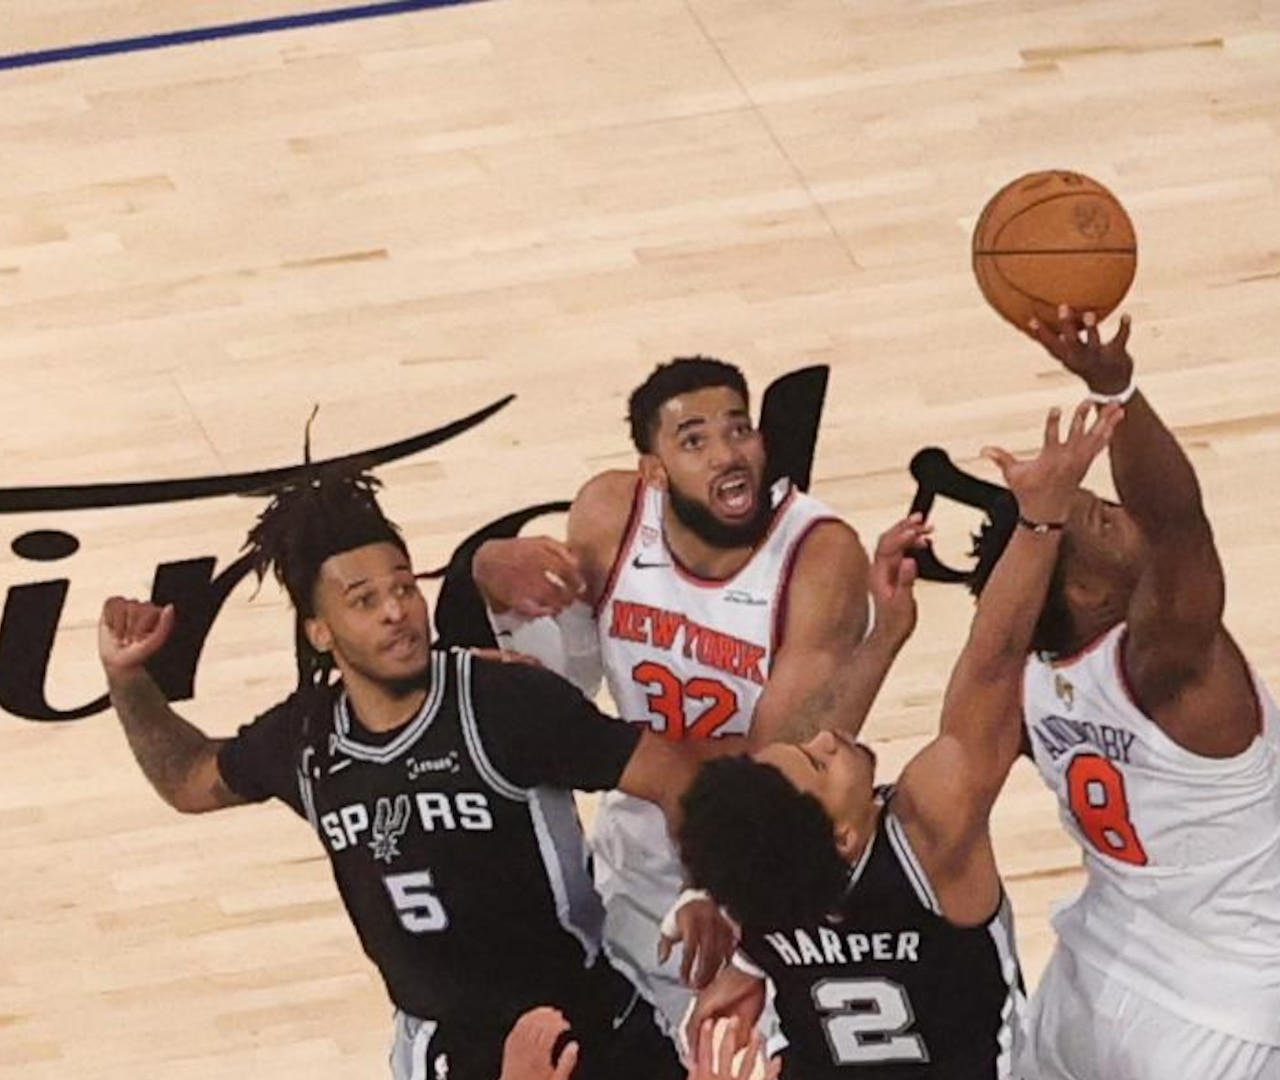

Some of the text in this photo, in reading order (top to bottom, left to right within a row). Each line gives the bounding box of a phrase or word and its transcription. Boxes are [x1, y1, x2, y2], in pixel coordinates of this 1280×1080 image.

[608, 598, 767, 687] NEW YORK
[631, 660, 748, 742] 32
[1065, 752, 1148, 867] 8
[382, 868, 450, 933] 5
[765, 926, 920, 966] HARPER
[810, 976, 931, 1067] 2
